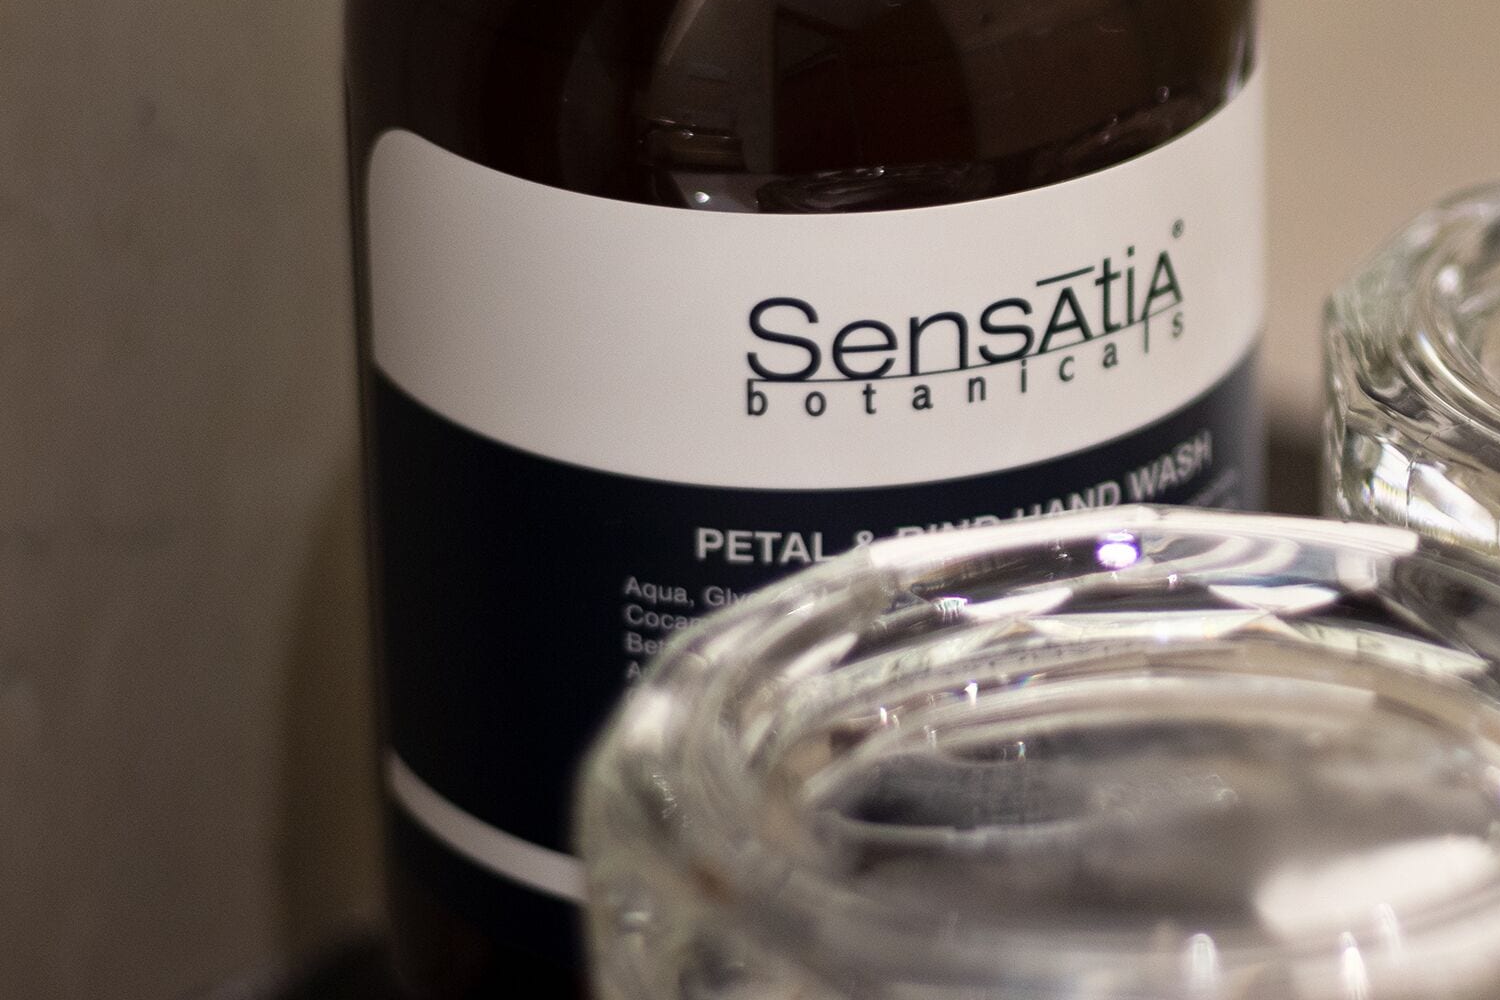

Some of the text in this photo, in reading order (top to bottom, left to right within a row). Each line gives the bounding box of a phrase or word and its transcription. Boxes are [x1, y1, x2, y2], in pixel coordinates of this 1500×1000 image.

[746, 311, 1184, 417] botanicals
[695, 527, 832, 563] PETAL
[1126, 430, 1213, 500] WASH
[624, 576, 695, 607] Aqua,
